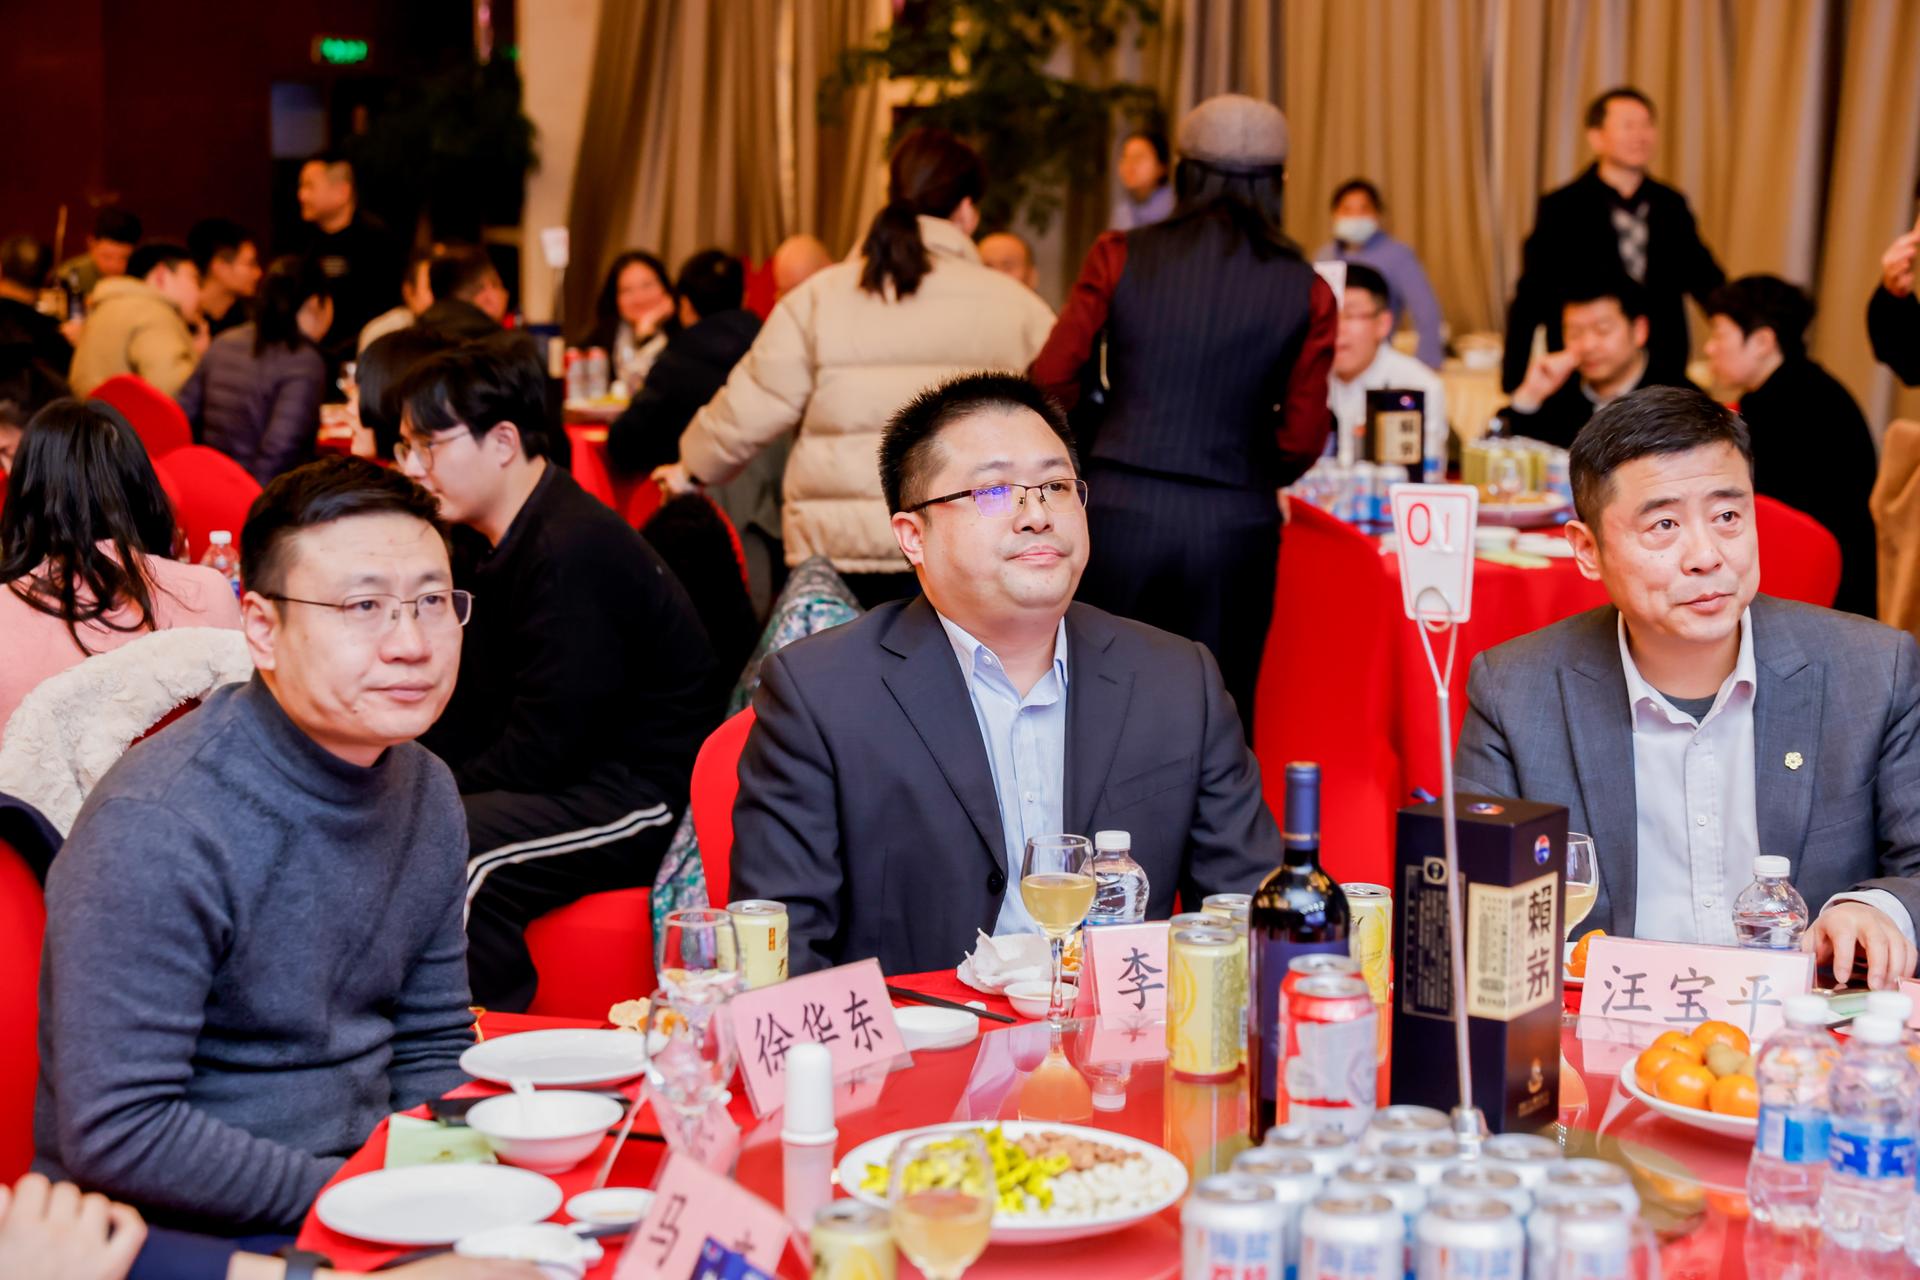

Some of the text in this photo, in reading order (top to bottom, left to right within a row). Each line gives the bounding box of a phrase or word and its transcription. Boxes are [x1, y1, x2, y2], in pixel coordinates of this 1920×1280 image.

[1117, 947, 1165, 1011] 李
[1601, 965, 1782, 1036] 汪宝平
[755, 990, 883, 1078] 徐华东
